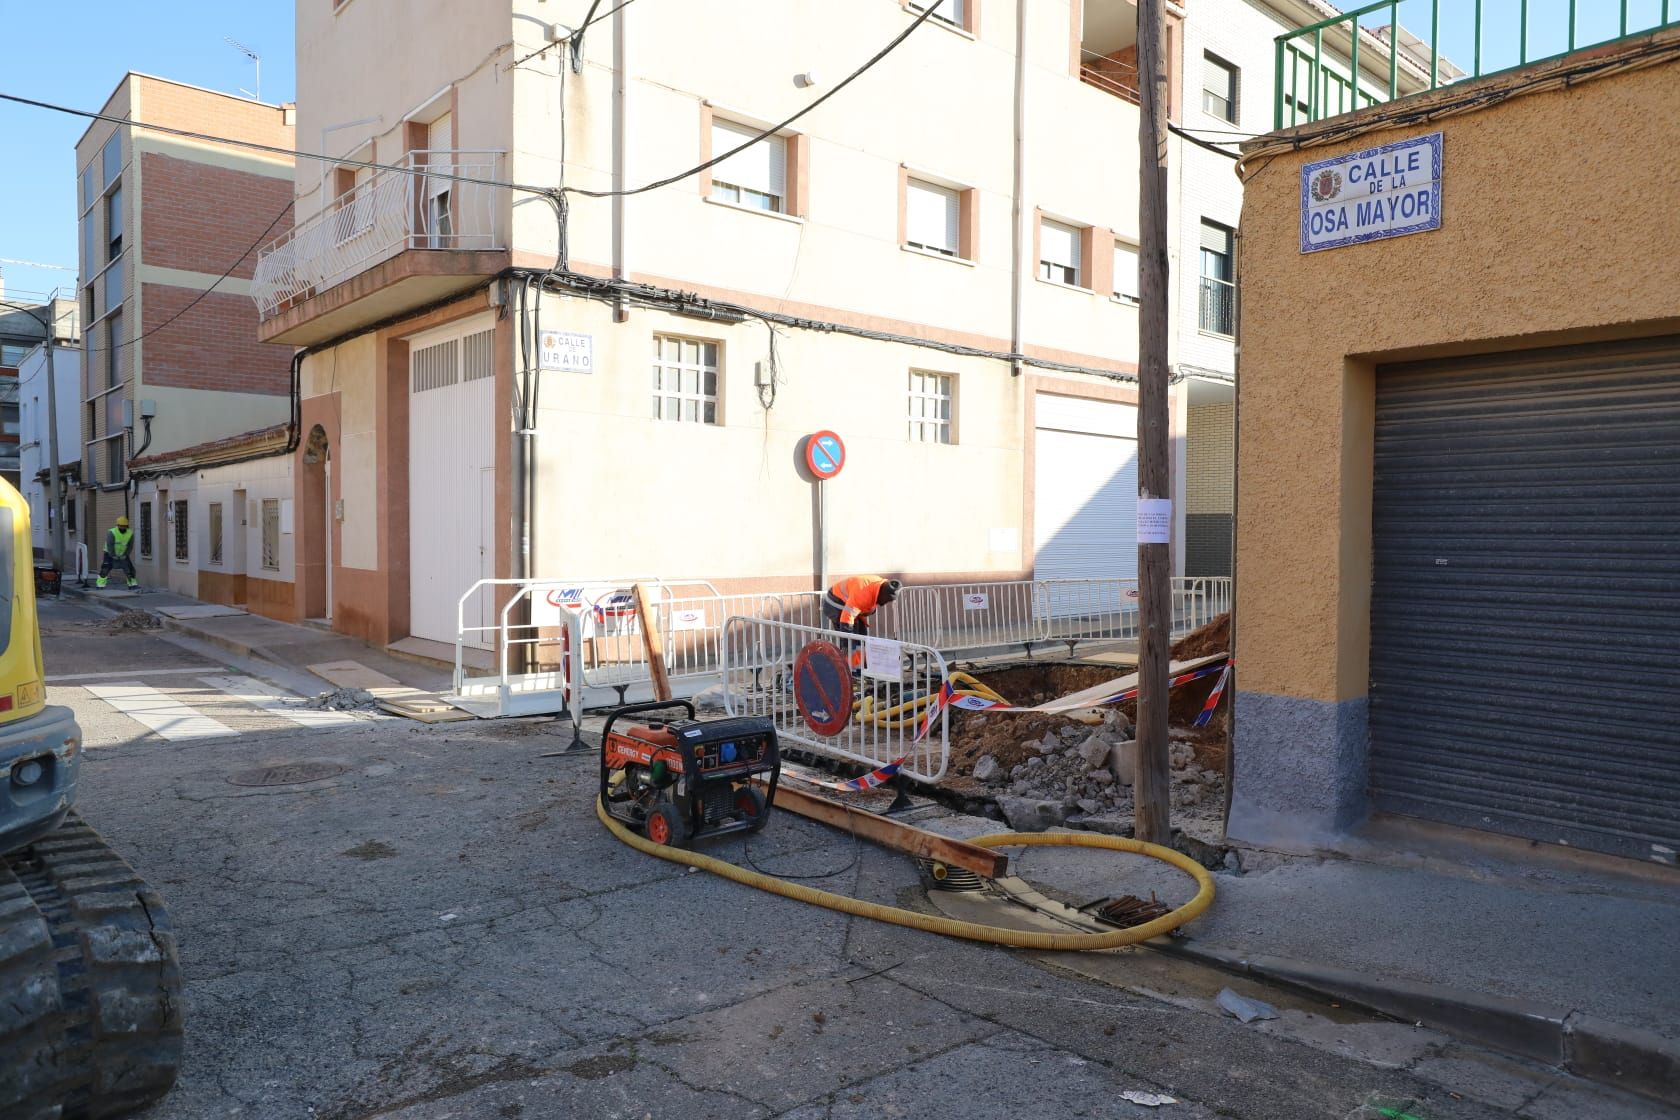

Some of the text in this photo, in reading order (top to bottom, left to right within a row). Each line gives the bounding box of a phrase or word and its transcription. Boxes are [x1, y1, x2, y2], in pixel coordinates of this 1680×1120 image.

[1348, 151, 1420, 184] CALLE
[1369, 176, 1406, 195] DE LA
[1310, 190, 1430, 236] OSA MAYOR
[558, 337, 585, 348] CALLE
[543, 351, 590, 367] URANO
